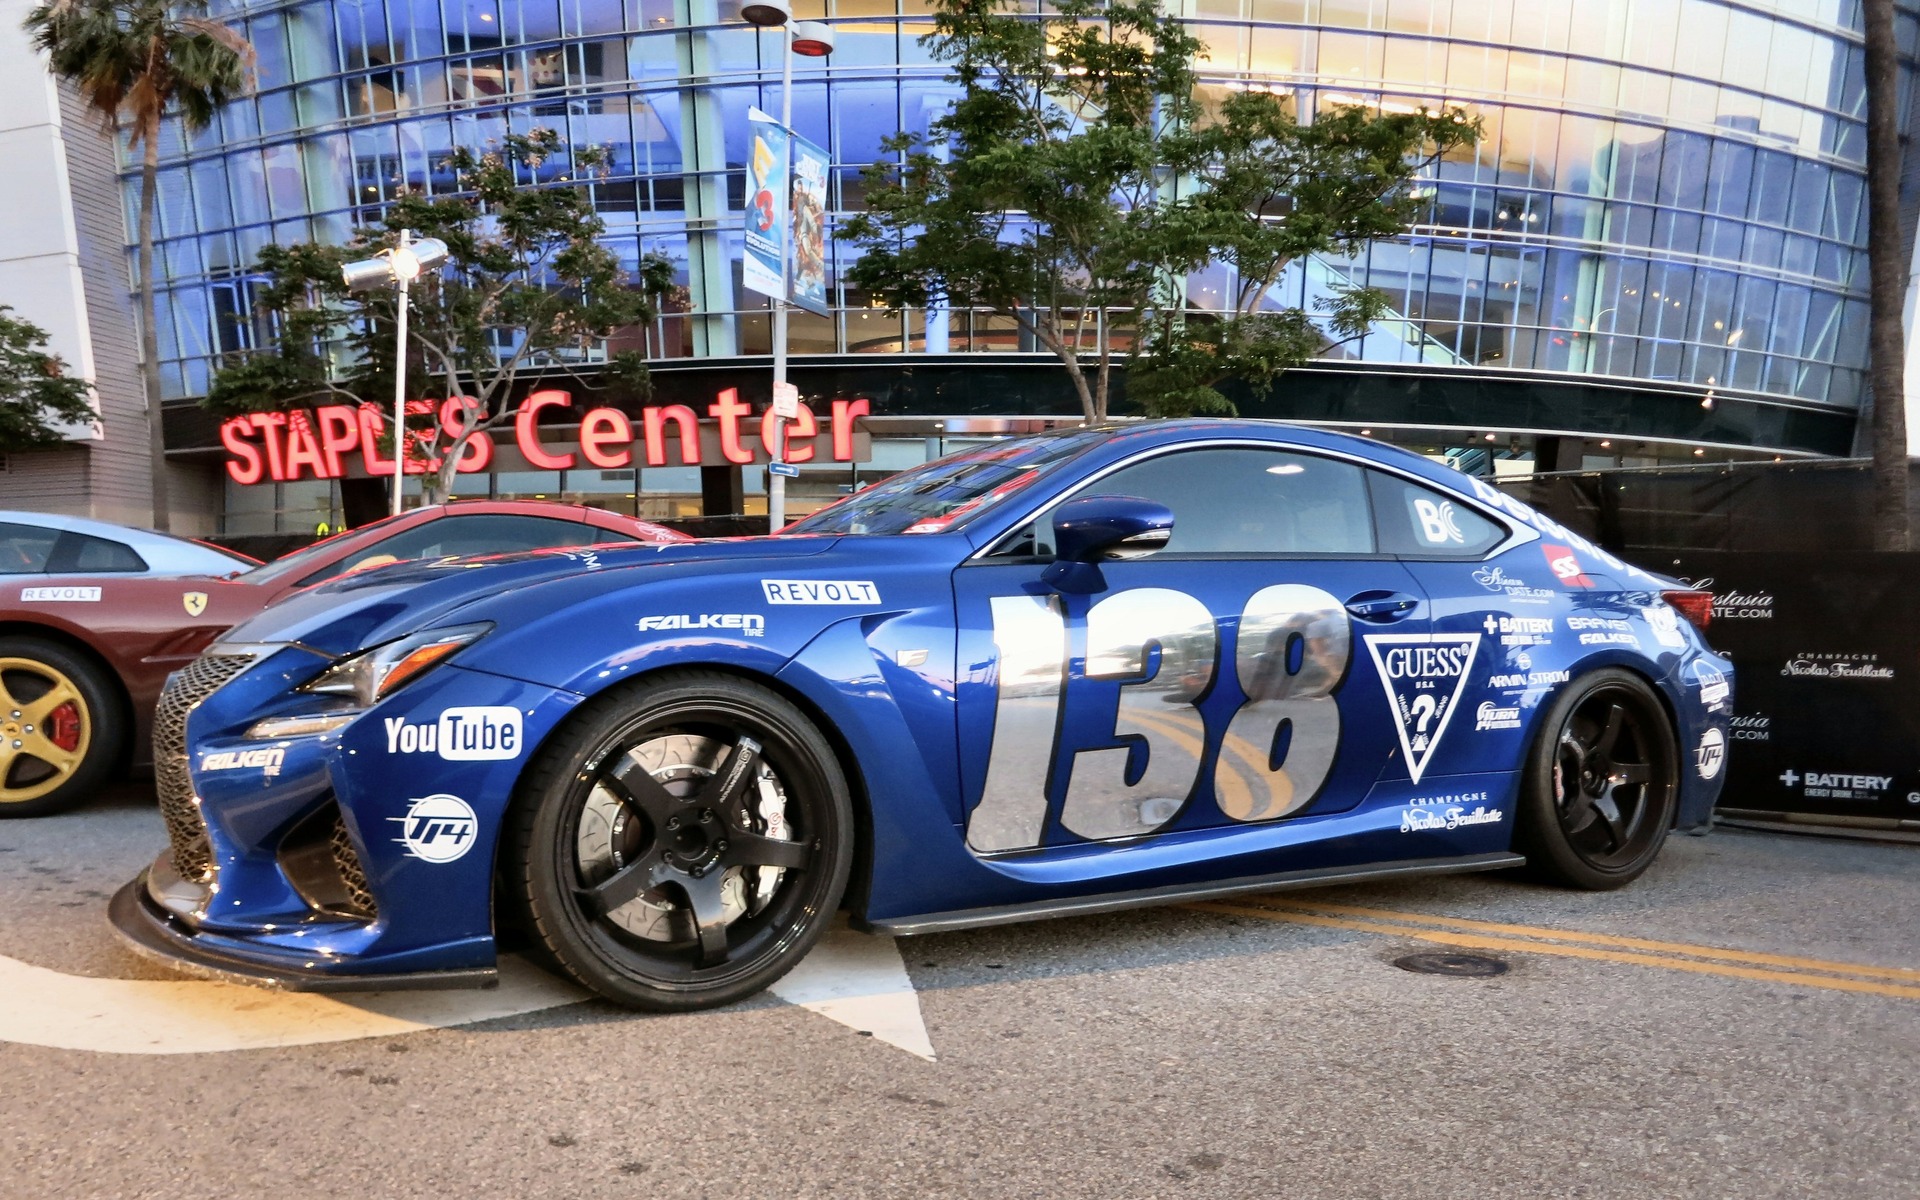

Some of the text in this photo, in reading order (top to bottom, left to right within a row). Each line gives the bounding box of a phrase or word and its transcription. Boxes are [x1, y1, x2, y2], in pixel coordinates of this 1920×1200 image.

[220, 393, 494, 486] STAPLES
[515, 388, 870, 472] Center
[25, 588, 98, 599] REVOLT
[767, 583, 871, 601] REVOLT
[636, 614, 765, 631] FALKEN
[1499, 617, 1553, 633] BATTERY
[1566, 617, 1635, 632] BRAVEN
[743, 628, 765, 637] TIRE
[1579, 633, 1640, 645] FALKEN
[1386, 647, 1464, 678] GUESS
[1797, 652, 1878, 661] CHAMPAGNE
[1780, 659, 1830, 676] Nicolas
[1487, 673, 1527, 688] ARMIN
[966, 583, 1352, 853] 138
[201, 749, 285, 771] FALKEN
[1804, 772, 1893, 790] BATTERY
[1410, 792, 1487, 807] CHAMPAGNE
[1400, 808, 1447, 833] Nicolas
